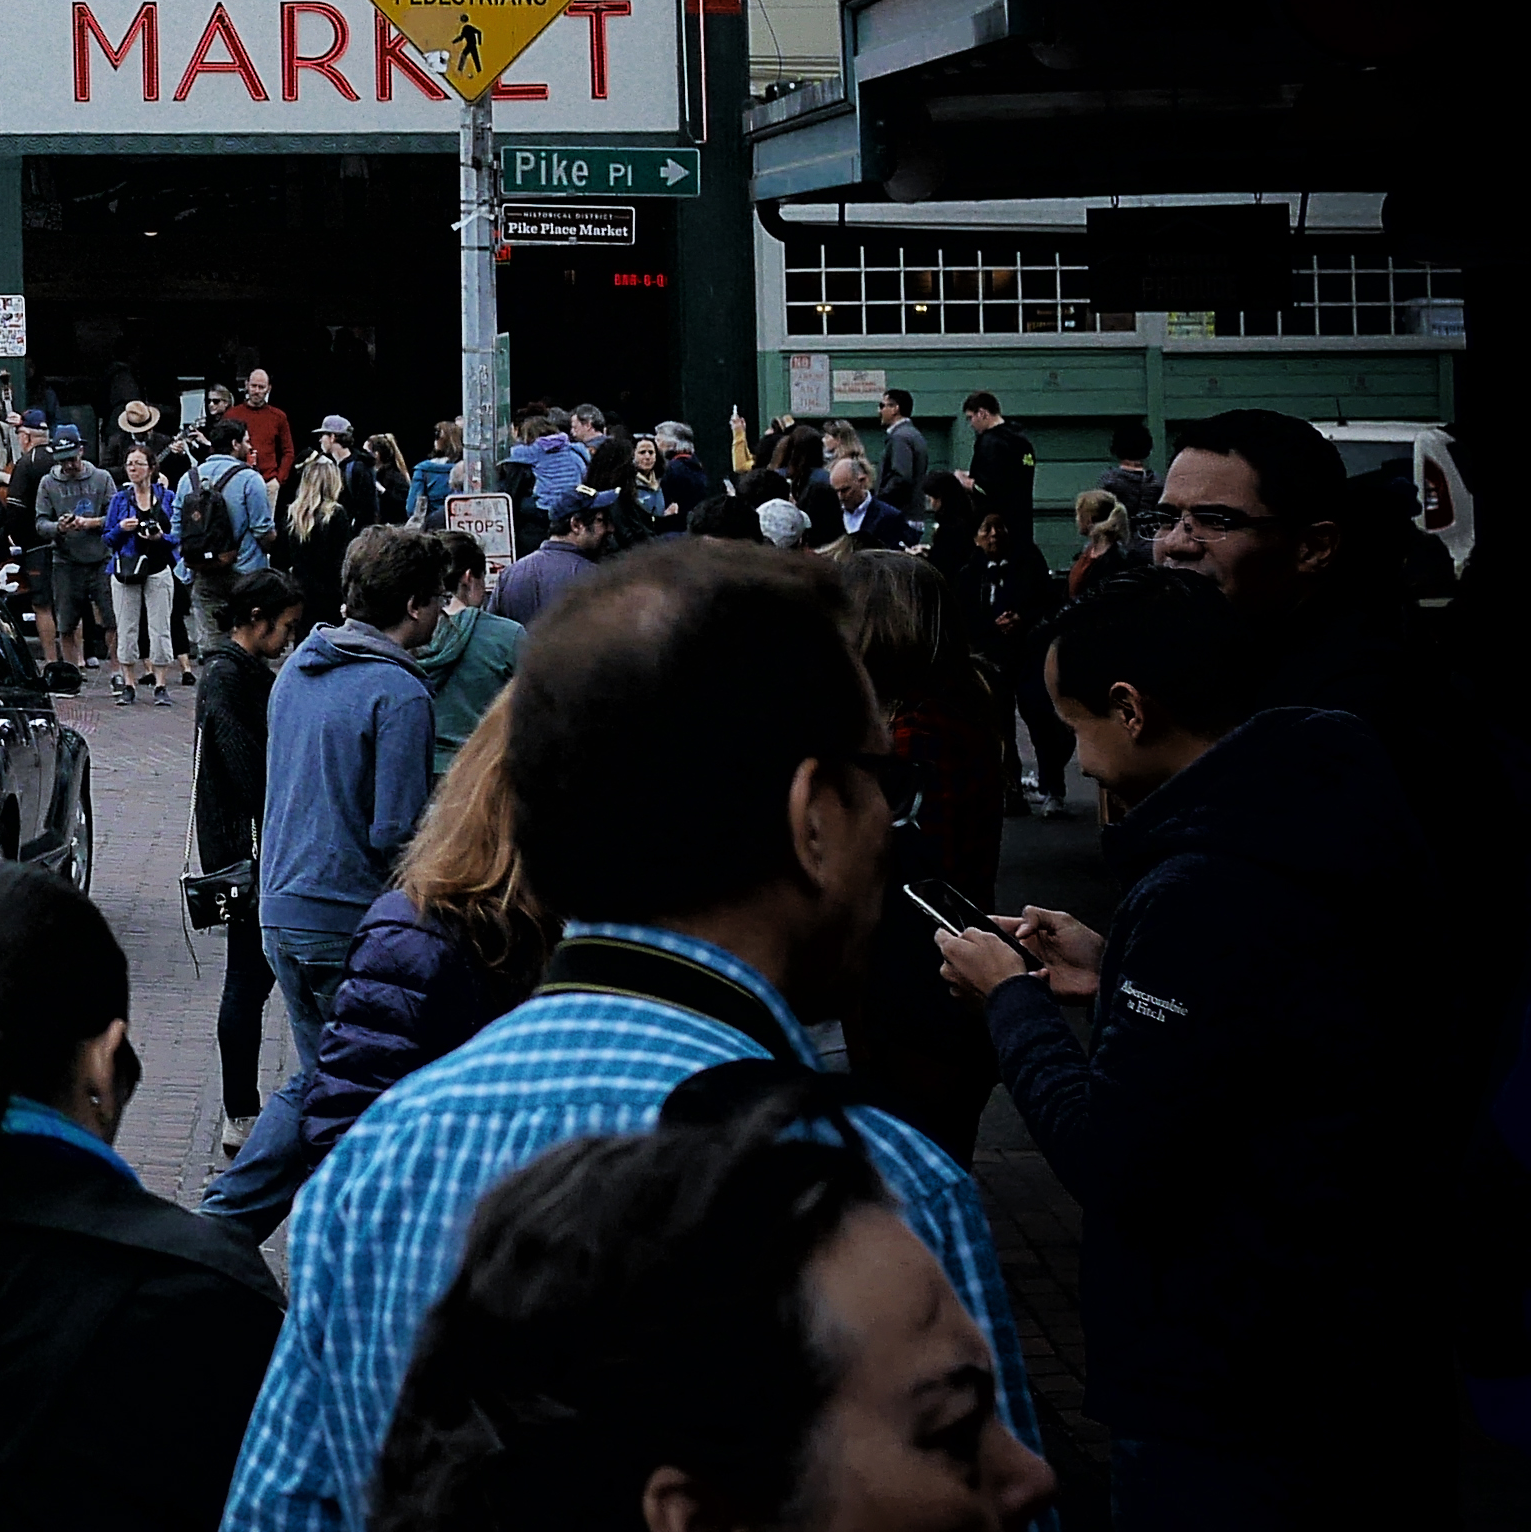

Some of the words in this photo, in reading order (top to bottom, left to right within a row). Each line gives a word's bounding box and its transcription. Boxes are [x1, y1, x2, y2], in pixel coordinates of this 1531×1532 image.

[72, 0, 632, 105] MARKT
[514, 151, 589, 187] Pike
[608, 163, 633, 187] Pl
[508, 222, 538, 235] Pike
[540, 223, 577, 236] Place
[579, 224, 629, 237] Market
[456, 520, 504, 535] STOPS
[1121, 979, 1189, 1017] Abercrombie
[1135, 1000, 1166, 1023] Fitch
